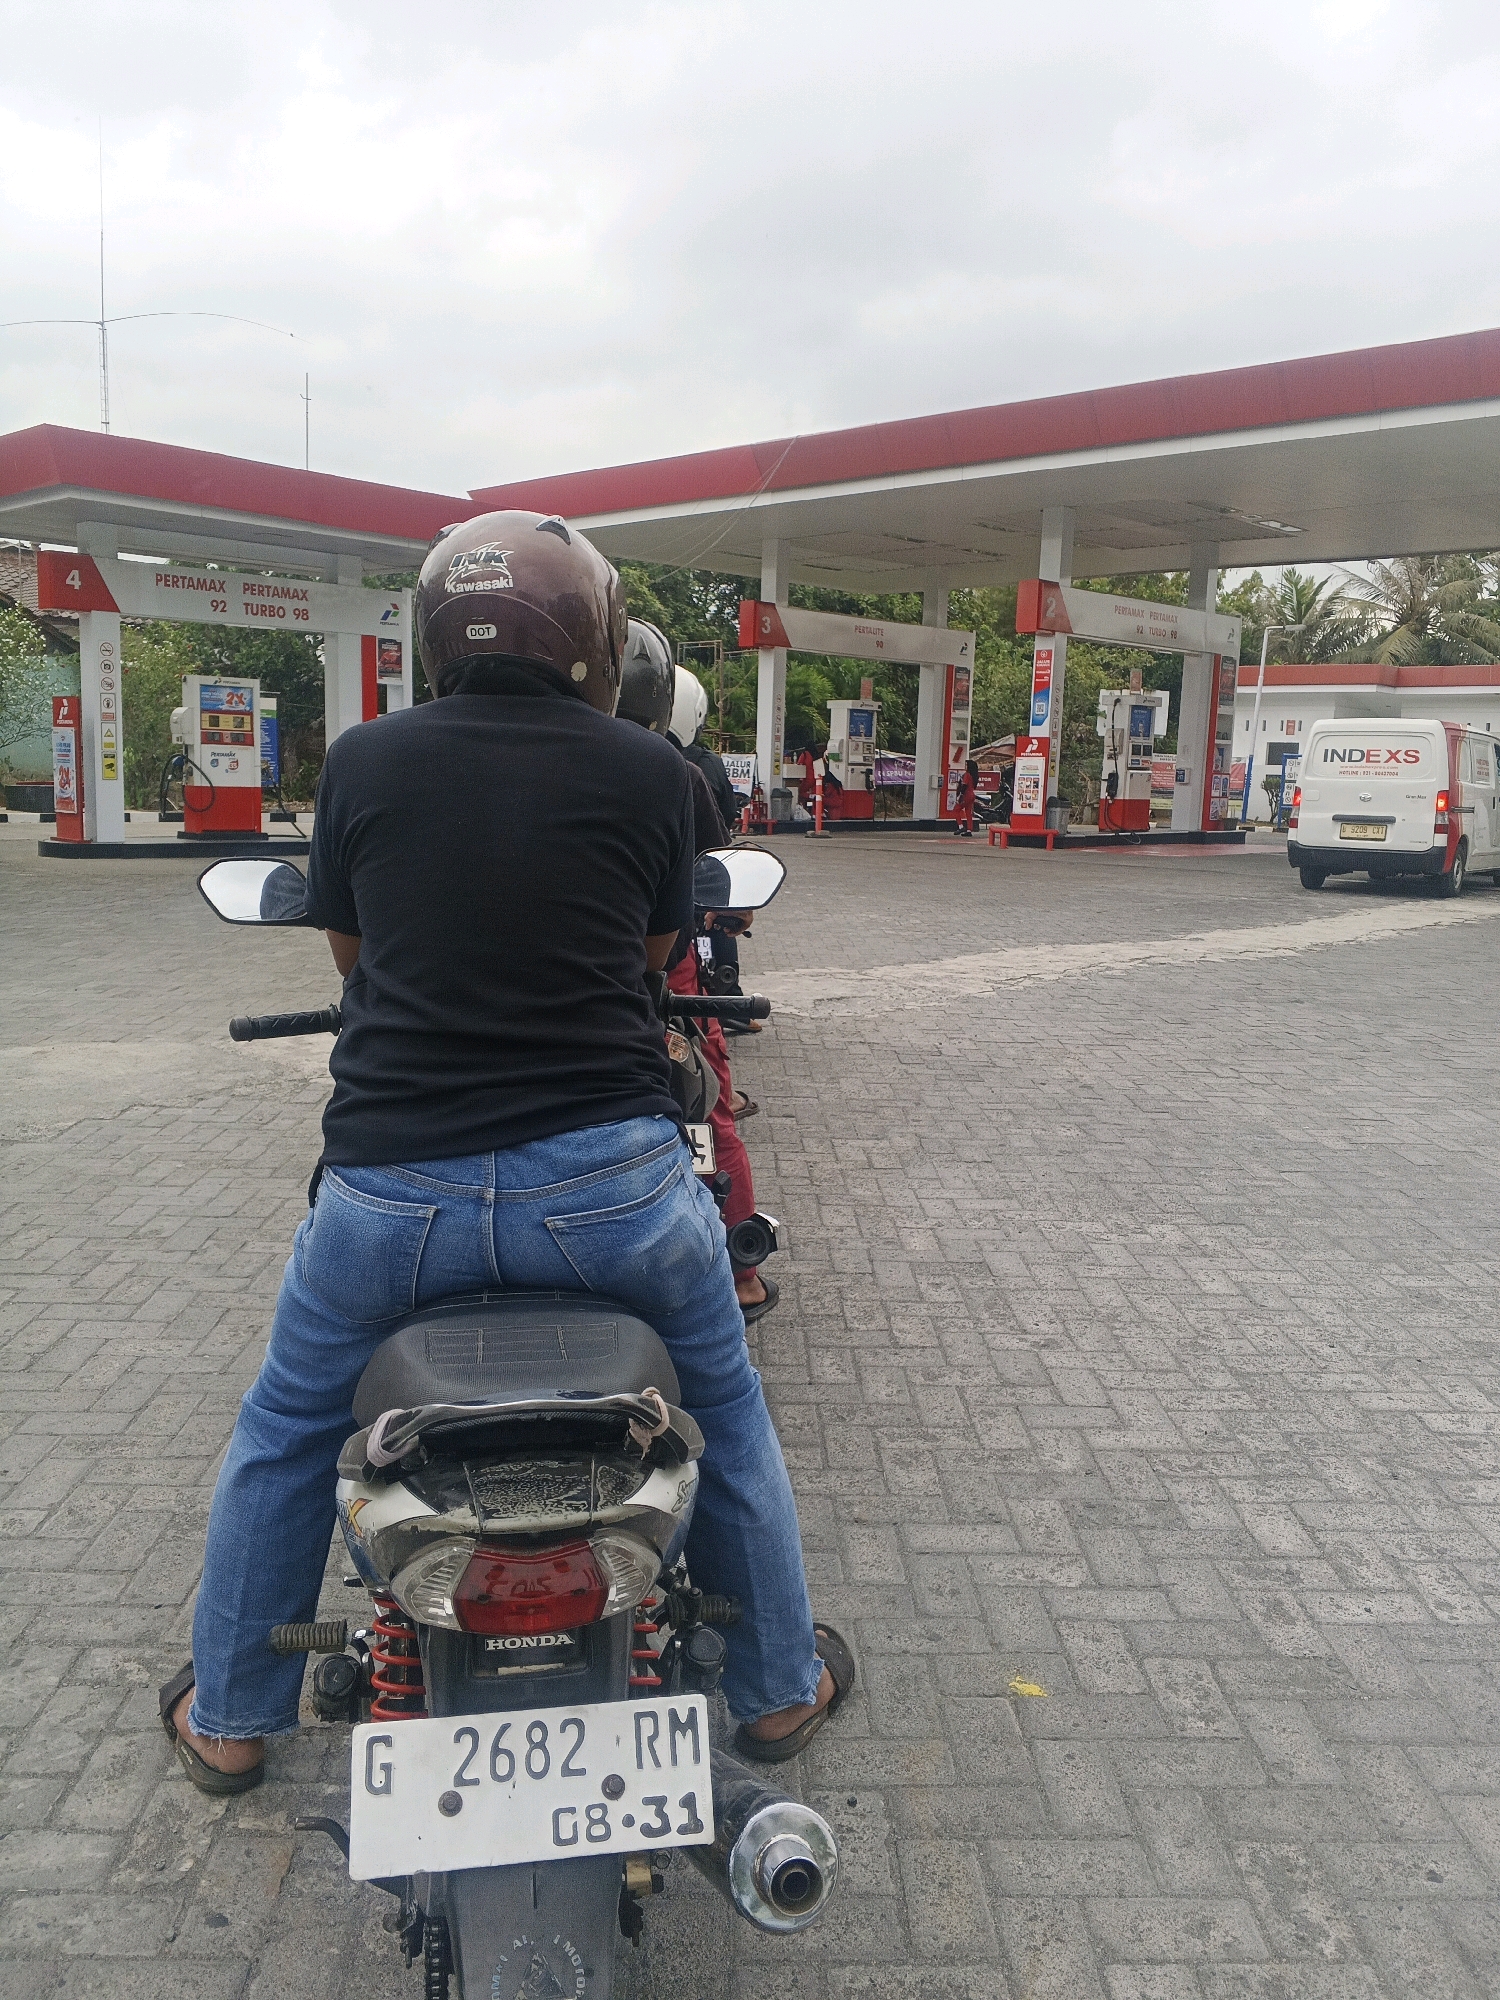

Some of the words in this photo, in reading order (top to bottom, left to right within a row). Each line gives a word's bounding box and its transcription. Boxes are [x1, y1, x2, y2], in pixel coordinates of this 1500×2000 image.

[65, 569, 81, 590] 4
[155, 572, 226, 594] PERTAMAX
[242, 582, 309, 602] PERTAMAX
[446, 576, 514, 594] Kawasaki
[210, 600, 227, 613] 92
[243, 603, 286, 619] TURBO
[293, 607, 309, 621] 98
[1046, 597, 1056, 618] 2
[1114, 605, 1145, 618] PERTAMAX
[1150, 611, 1179, 623] PERTAMAX
[470, 627, 492, 637] DOT
[761, 616, 771, 634] 3
[855, 625, 884, 636] PERTALITE
[1136, 625, 1144, 634] 92
[1149, 627, 1166, 638] TURBO
[1323, 748, 1420, 764] INDEXS
[486, 1633, 575, 1652] HONDA
[365, 1734, 393, 1796] G
[453, 1717, 587, 1788] 2682
[633, 1706, 701, 1770] RM
